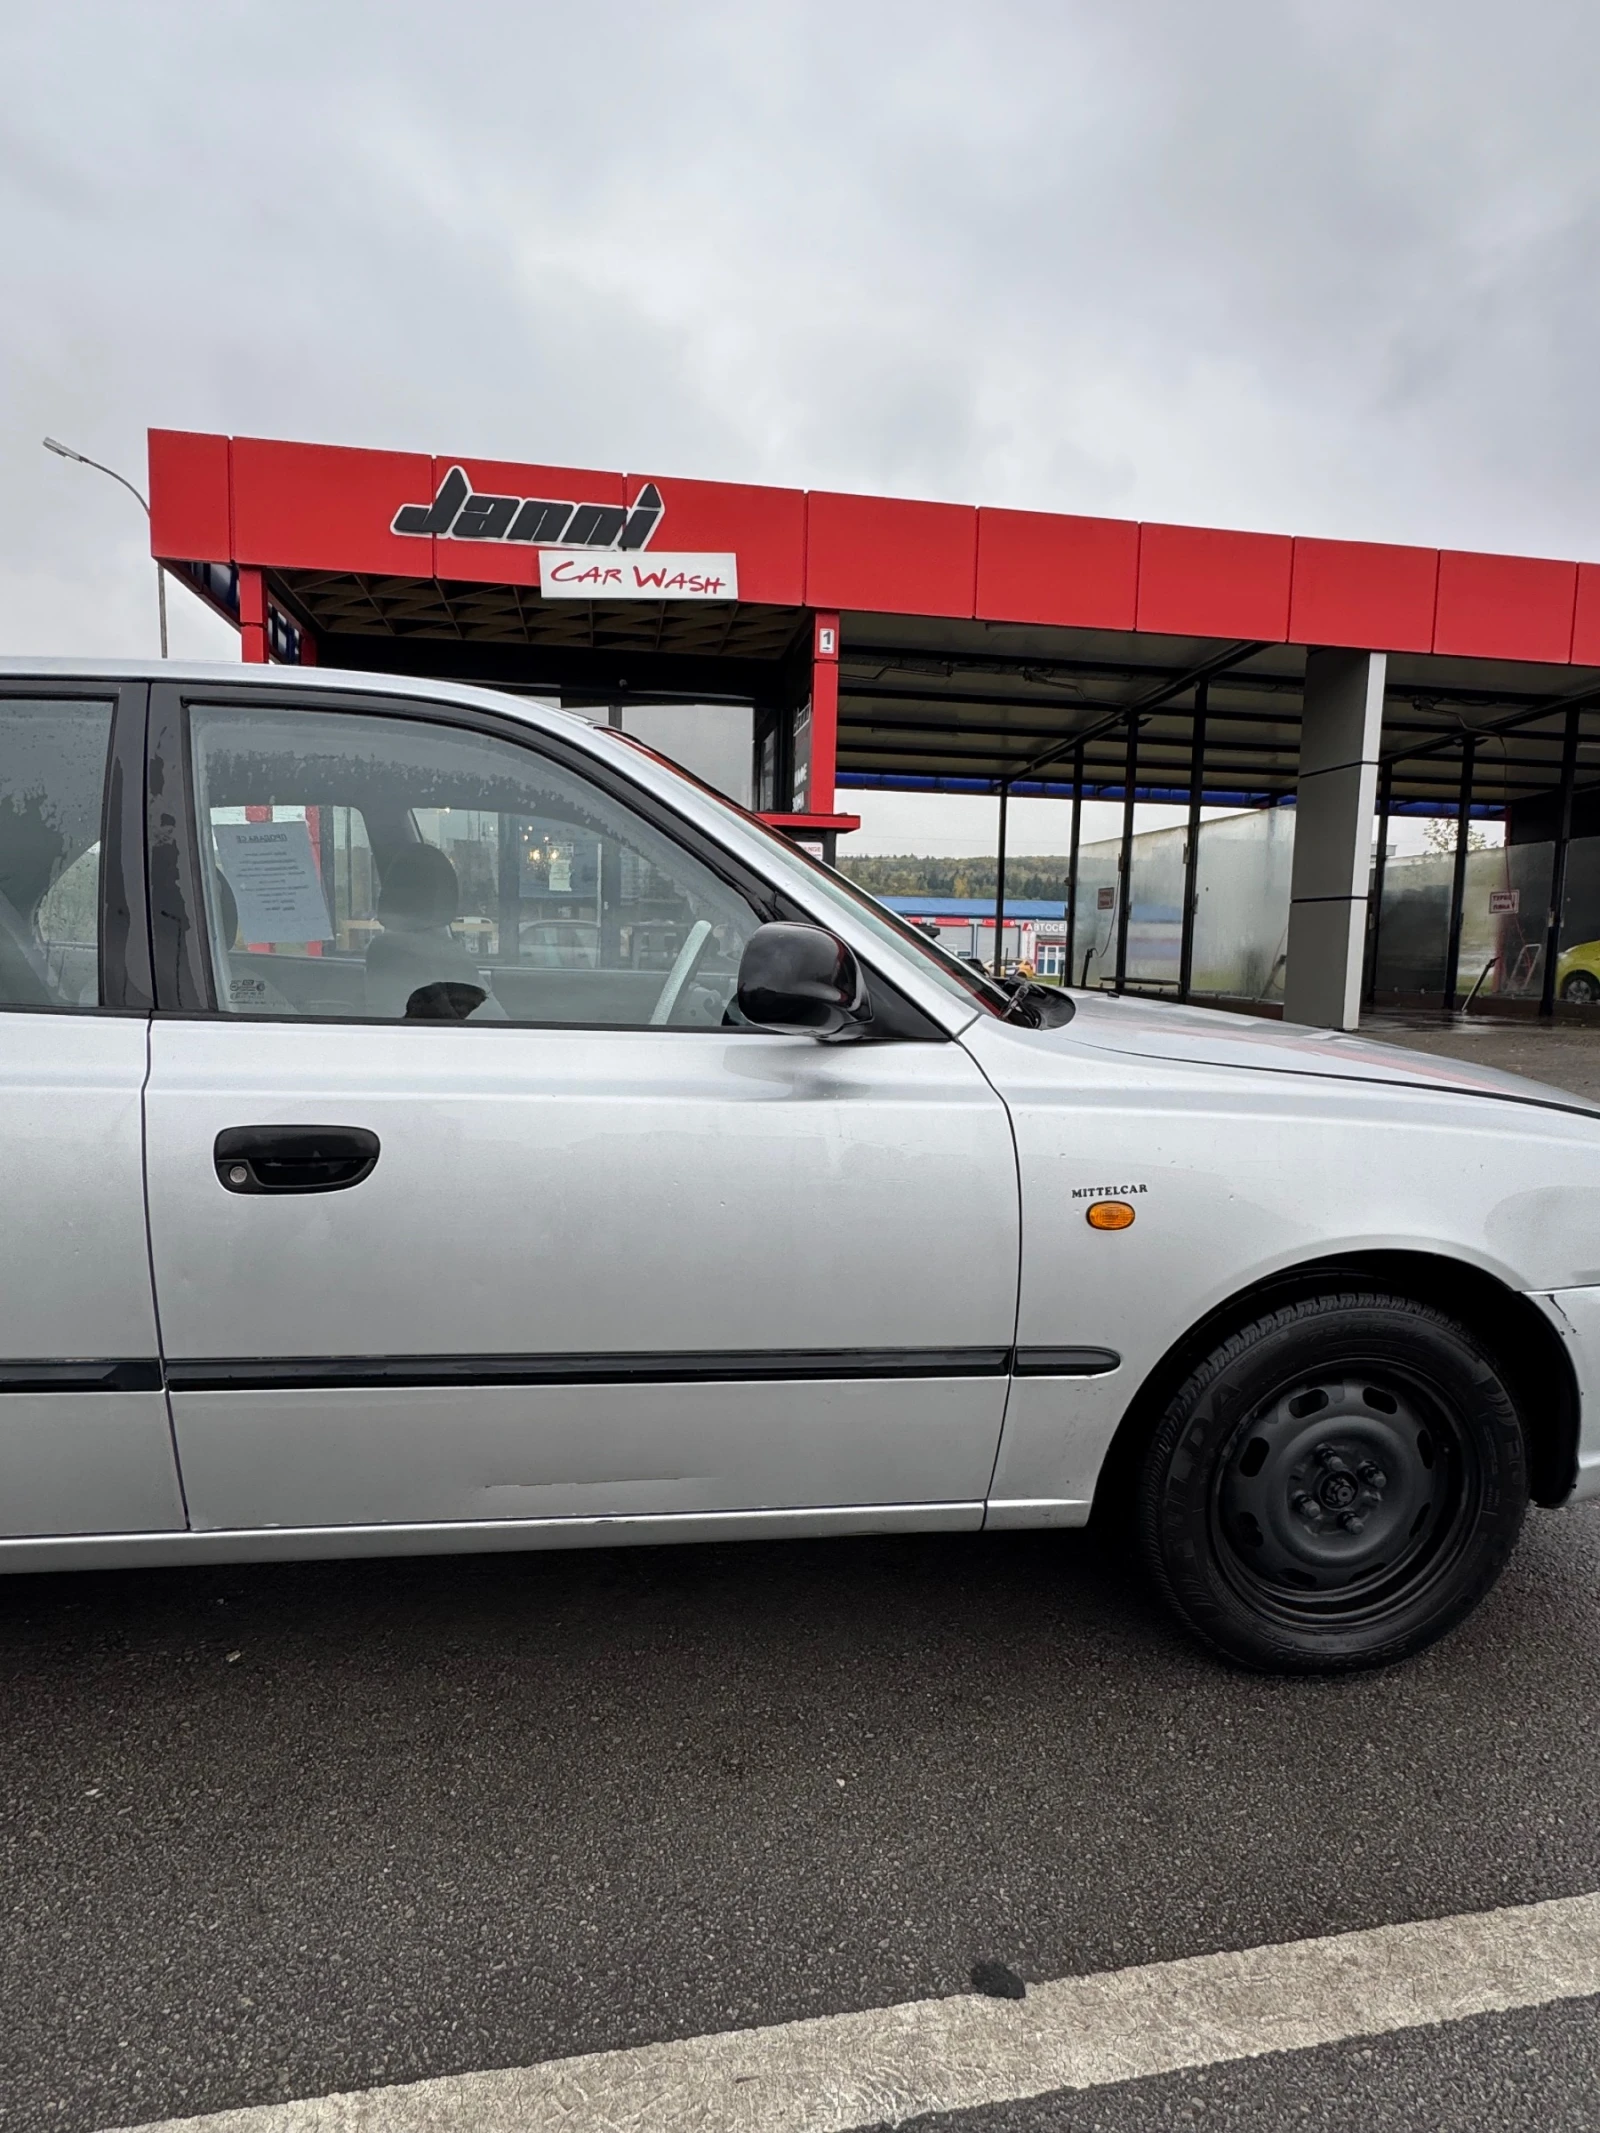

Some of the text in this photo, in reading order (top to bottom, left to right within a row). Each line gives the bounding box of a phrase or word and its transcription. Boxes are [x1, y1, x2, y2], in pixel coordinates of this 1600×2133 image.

[391, 465, 665, 551] Janni
[550, 560, 726, 595] CAR WASH
[823, 631, 831, 645] 1
[1026, 922, 1067, 932] АВТОСЕ
[1071, 1184, 1148, 1199] MITTELCAR
